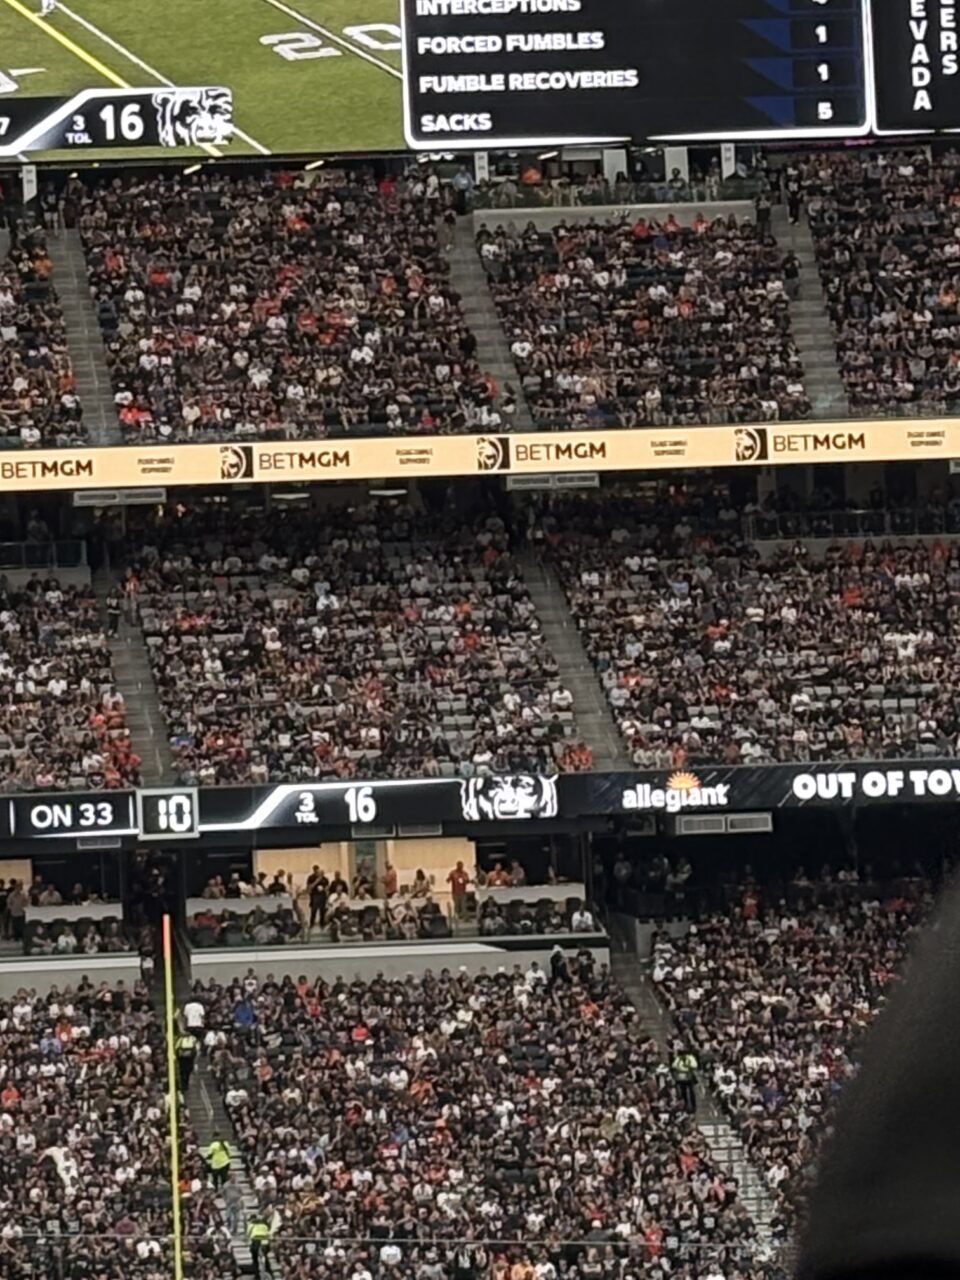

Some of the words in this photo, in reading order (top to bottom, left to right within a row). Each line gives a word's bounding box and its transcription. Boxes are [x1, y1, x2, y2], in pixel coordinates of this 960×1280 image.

[418, 34, 501, 54] FORCED
[506, 32, 604, 52] FUMBLES
[815, 26, 827, 43] 1
[419, 73, 505, 94] FUMBLE
[509, 70, 639, 91] RECOVERIES
[817, 65, 828, 81] 1
[818, 103, 833, 119] 5
[73, 115, 85, 131] 3
[99, 103, 144, 140] 16
[420, 113, 492, 133] SACKS
[516, 441, 606, 462] BETMGM
[773, 433, 866, 452] BETMGM
[1, 459, 93, 479] BETMGM
[259, 450, 351, 470] BETMGM
[792, 773, 856, 800] OUT
[862, 771, 904, 797] OF
[298, 792, 315, 812] 3
[344, 787, 375, 823] 16
[622, 784, 730, 813] allegiant
[31, 805, 73, 829] ON
[79, 803, 113, 826] 33
[157, 795, 192, 832] 10
